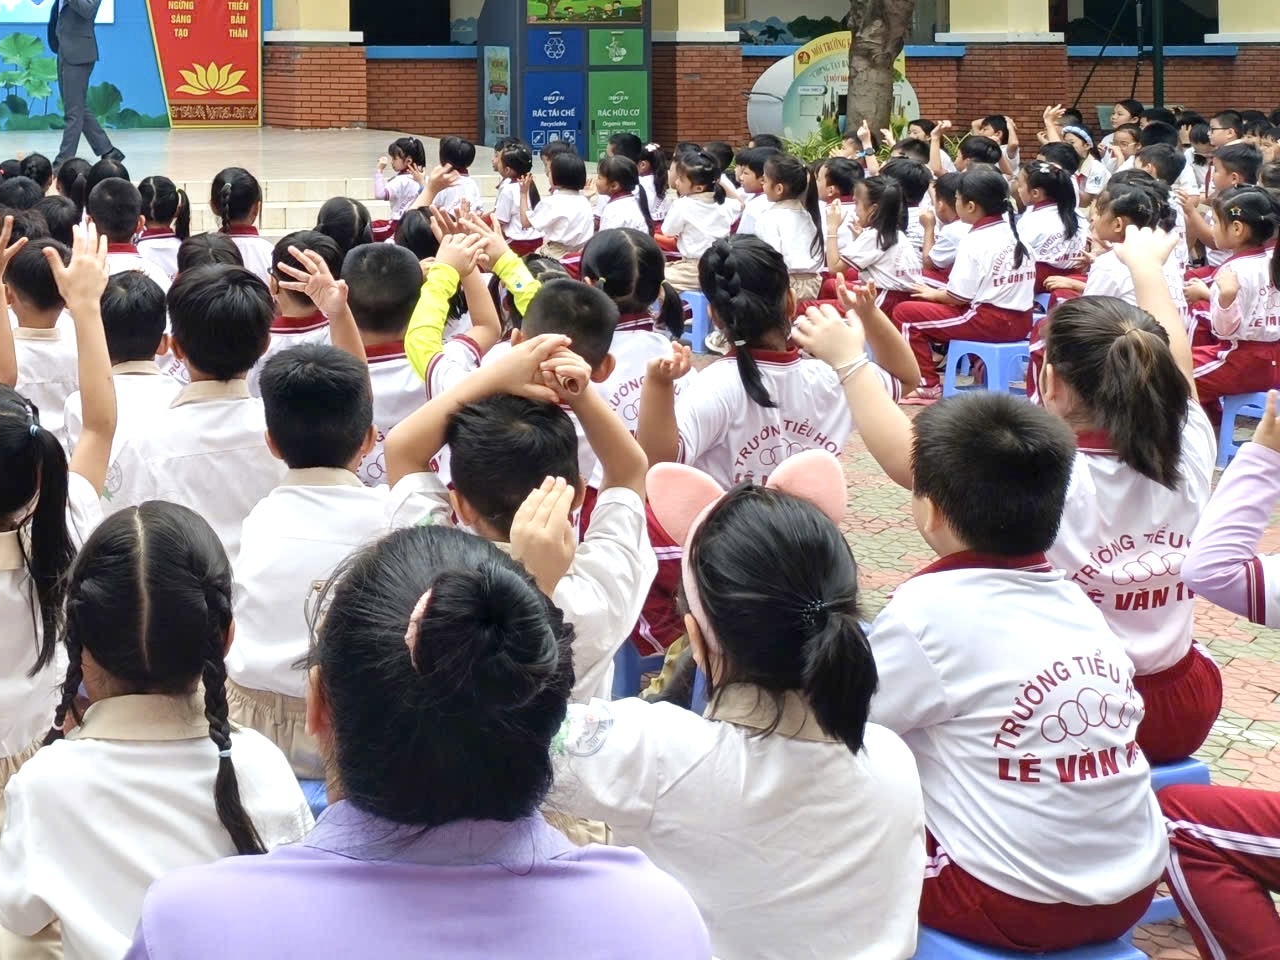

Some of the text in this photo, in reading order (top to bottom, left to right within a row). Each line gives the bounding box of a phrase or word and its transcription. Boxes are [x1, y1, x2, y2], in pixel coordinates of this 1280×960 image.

[1114, 587, 1170, 611] VĂN
[993, 648, 1120, 749] TRƯỜNG TIỂU
[998, 752, 1042, 783] LÊ
[1055, 746, 1120, 783] VĂN
